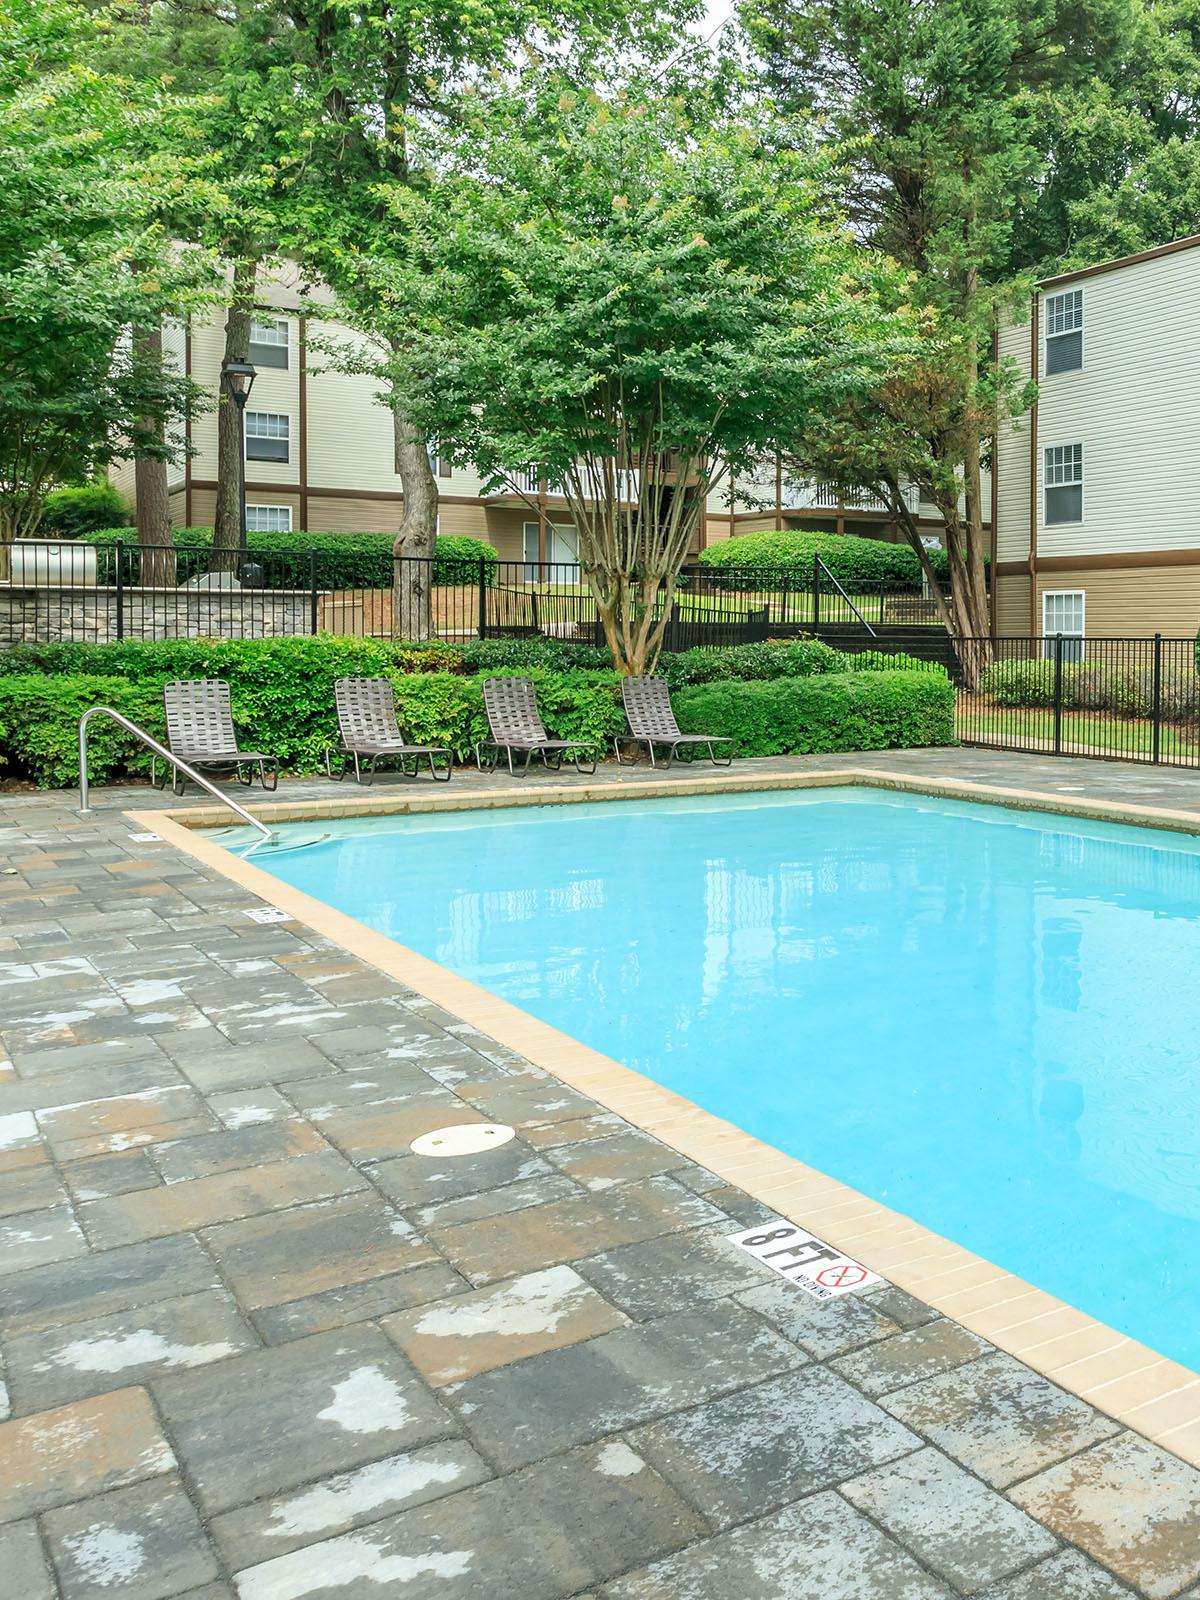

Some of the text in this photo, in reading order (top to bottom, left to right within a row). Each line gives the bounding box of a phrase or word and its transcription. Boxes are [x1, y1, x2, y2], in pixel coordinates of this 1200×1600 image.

[741, 1227, 841, 1271] 8 FT
[792, 1274, 832, 1298] NO DIVING
